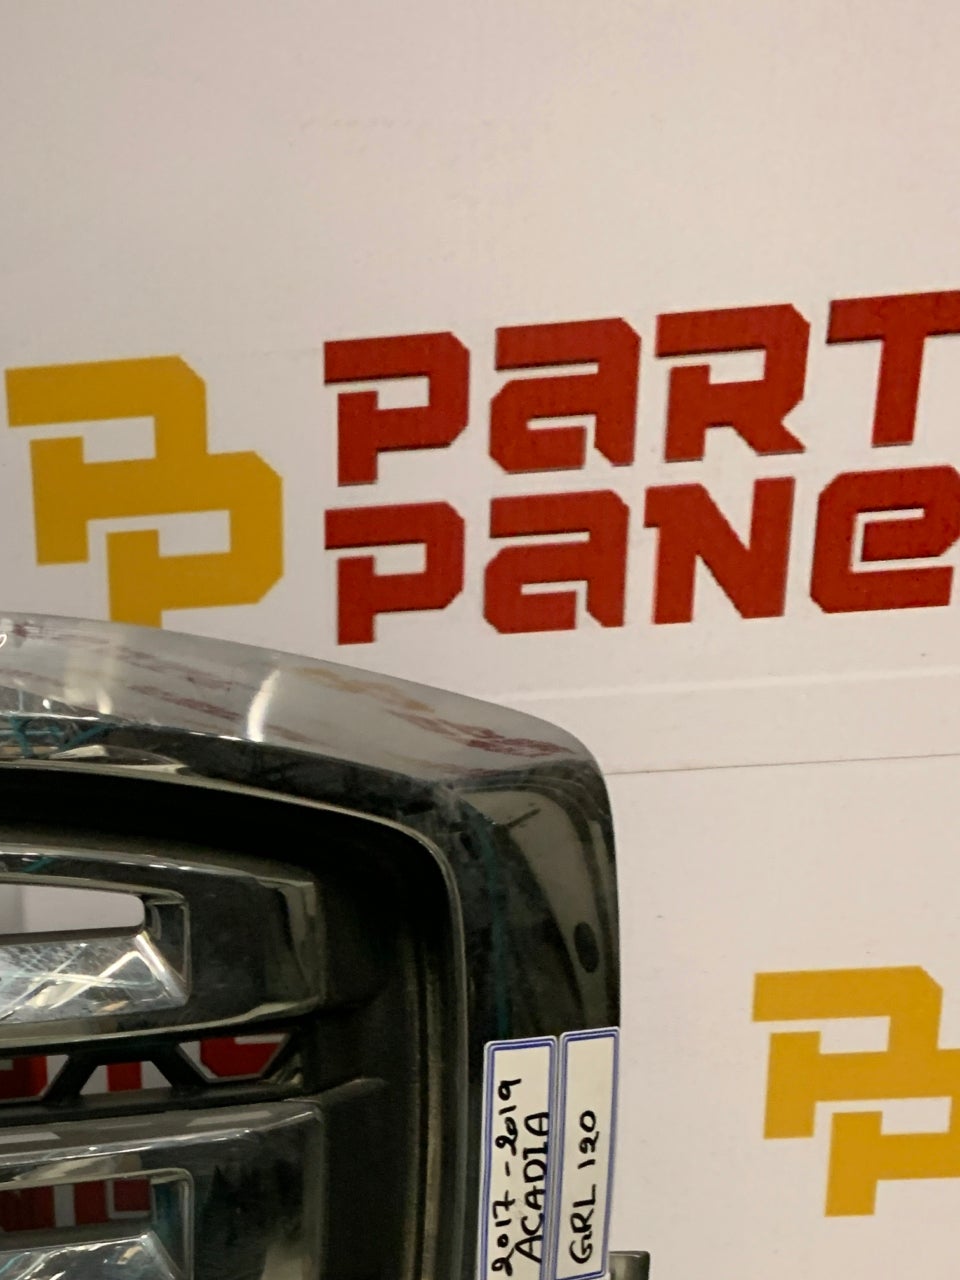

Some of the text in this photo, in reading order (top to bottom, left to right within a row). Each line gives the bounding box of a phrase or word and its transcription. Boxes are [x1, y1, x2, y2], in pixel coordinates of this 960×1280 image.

[495, 1078, 522, 1156] 2019
[491, 1189, 515, 1277] 2017
[514, 1111, 550, 1264] ACADIA
[569, 1109, 600, 1264] GRL 120
